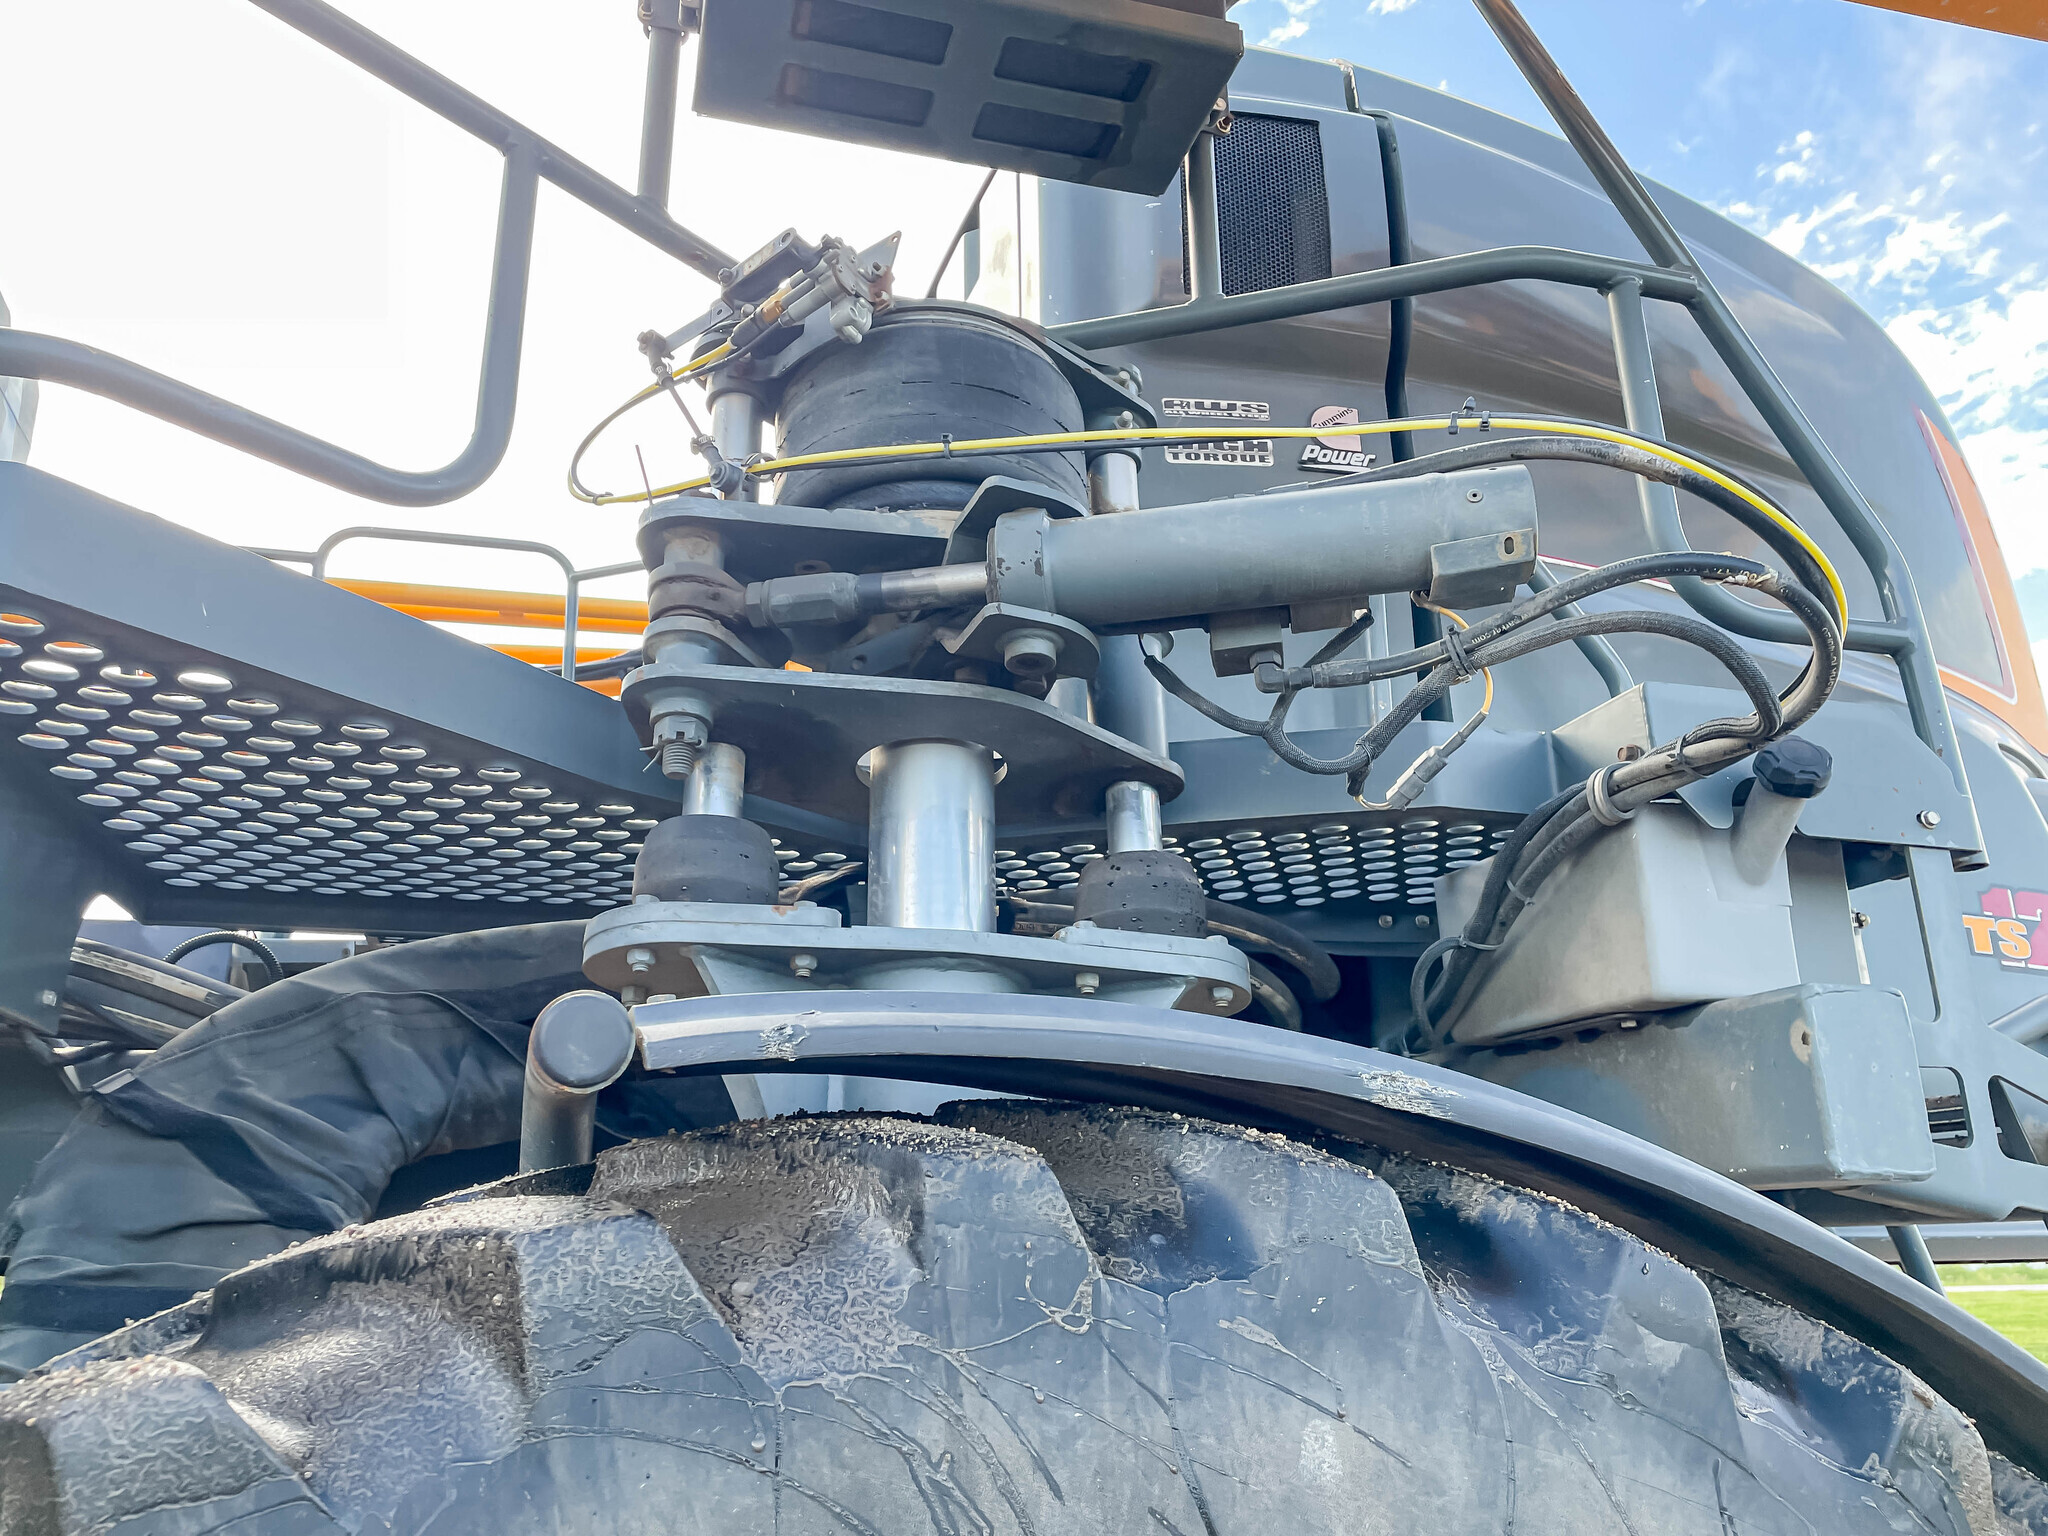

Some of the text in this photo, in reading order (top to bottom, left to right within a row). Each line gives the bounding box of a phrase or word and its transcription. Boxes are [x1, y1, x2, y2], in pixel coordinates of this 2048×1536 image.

[1188, 410, 1230, 418] WHEEL
[1168, 451, 1272, 464] TORQUE
[1301, 444, 1376, 467] Power
[1961, 914, 2033, 960] TS
